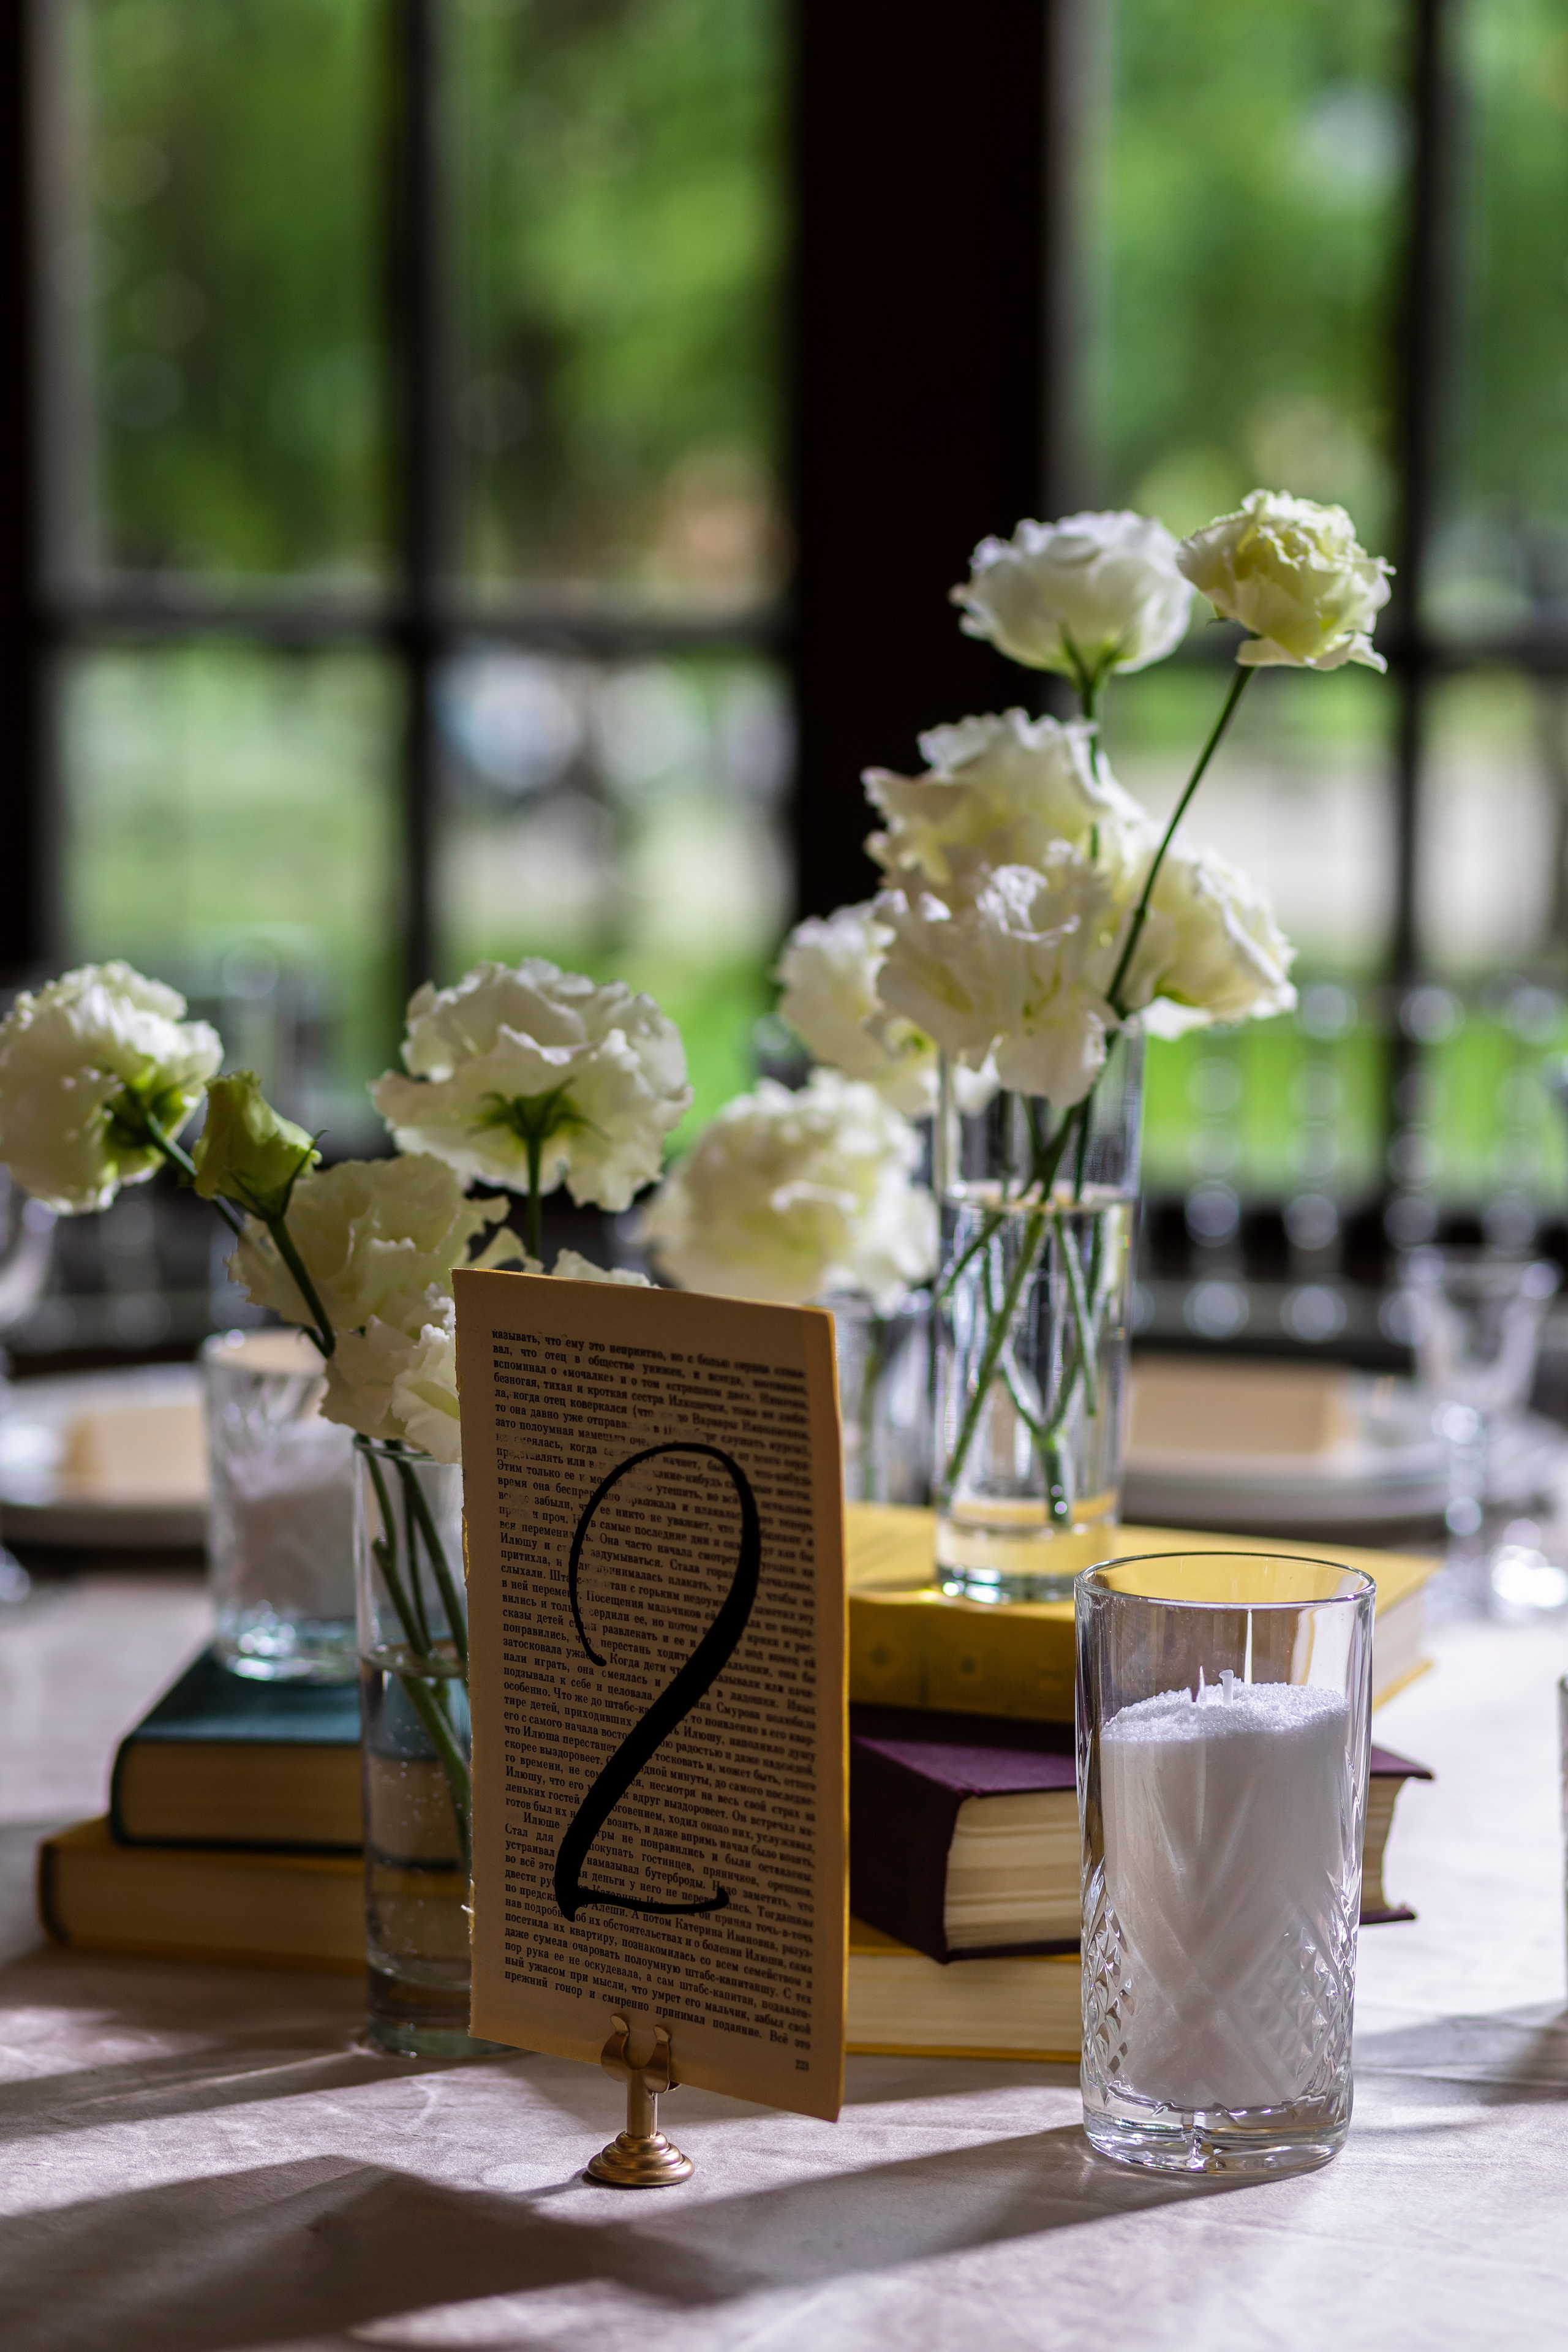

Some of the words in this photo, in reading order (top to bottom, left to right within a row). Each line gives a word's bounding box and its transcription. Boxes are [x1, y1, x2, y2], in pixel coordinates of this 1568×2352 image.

[491, 1330, 541, 1346] казывать,
[544, 1336, 562, 1347] что
[565, 1338, 586, 1352] ему
[588, 1341, 606, 1352] это
[492, 1344, 513, 1357] вал,
[519, 1348, 538, 1359] что
[544, 1351, 568, 1364] отец
[587, 1354, 635, 1371] обществе
[492, 1359, 547, 1374] вспоминал
[562, 1368, 614, 1383] «мочалке»
[493, 1371, 540, 1390] безногая,
[543, 1380, 573, 1393] тихая
[587, 1386, 628, 1400] кроткая
[631, 1392, 665, 1406] сестра
[494, 1389, 510, 1401] ла,
[512, 1391, 541, 1404] когда
[543, 1395, 567, 1408] отец
[569, 1398, 628, 1415] коверкался
[494, 1403, 507, 1413] то
[509, 1405, 527, 1416] она
[529, 1408, 560, 1420] давно
[562, 1412, 584, 1424] уже
[495, 1417, 517, 1429] зато
[518, 1421, 575, 1437] полоумная
[566, 1457, 586, 1468] или
[569, 1442, 598, 1456] когда
[497, 1458, 523, 1474] Этим
[526, 1466, 561, 1479] только
[564, 1471, 575, 1481] ее
[497, 1476, 528, 1489] время
[532, 1481, 551, 1492] она
[533, 1494, 574, 1512] забыли,
[615, 1508, 646, 1521] никто
[541, 1512, 569, 1525] проч.
[599, 1521, 631, 1534] самые
[634, 1526, 687, 1541] последние
[599, 1532, 620, 1547] Она
[624, 1539, 653, 1551] часто
[500, 1531, 538, 1551] Илюшу
[590, 1548, 663, 1569] задумываться.
[500, 1549, 551, 1567] притихла,
[500, 1564, 546, 1580] слыхали.
[638, 1586, 680, 1601] горьким
[510, 1579, 529, 1592] ней
[502, 1594, 538, 1607] вились
[633, 1615, 648, 1627] ее,
[652, 1618, 665, 1628] но
[502, 1608, 532, 1621] сказы
[536, 1613, 565, 1626] детей
[601, 1624, 658, 1642] развлекать
[502, 1623, 570, 1644] понравились,
[600, 1638, 652, 1656] перестань
[502, 1637, 563, 1656] затосковала
[609, 1652, 640, 1670] Когда
[643, 1660, 666, 1673] дети
[503, 1652, 527, 1664] нали
[533, 1657, 570, 1674] играть,
[576, 1665, 595, 1676] она
[601, 1669, 648, 1685] смеялась
[503, 1666, 556, 1684] подзывала
[570, 1677, 592, 1691] себе
[607, 1685, 656, 1702] целовала.
[554, 1442, 761, 1922] 2
[503, 1681, 551, 1698] особенно.
[552, 1686, 573, 1702] Что
[573, 1694, 589, 1705] же
[590, 1697, 603, 1708] до
[503, 1695, 527, 1709] тире
[529, 1700, 560, 1716] детей,
[564, 1706, 633, 1727] приходивших
[503, 1711, 520, 1722] его
[528, 1715, 563, 1729] самого
[564, 1721, 599, 1736] начала
[675, 1742, 723, 1758] радостью
[504, 1725, 521, 1736] что
[522, 1724, 560, 1743] Илюша
[562, 1735, 617, 1754] перестанет
[654, 1752, 704, 1770] тосковать
[503, 1740, 538, 1754] скорее
[539, 1746, 603, 1766] выздоровеет.
[669, 1770, 712, 1788] минуты,
[504, 1754, 516, 1763] го
[519, 1756, 564, 1774] времени,
[568, 1765, 581, 1776] не
[649, 1781, 696, 1800] несмотря
[505, 1765, 546, 1785] Илюшу,
[548, 1776, 566, 1787] что
[568, 1780, 585, 1791] его
[632, 1792, 662, 1807] вдруг
[505, 1782, 546, 1799] леньких
[548, 1791, 581, 1805] гостей
[668, 1814, 698, 1828] ходил
[505, 1797, 532, 1811] готов
[532, 1800, 553, 1815] был
[554, 1806, 568, 1817] их
[606, 1817, 642, 1834] возить,
[652, 1826, 679, 1839] даже
[680, 1832, 718, 1847] впрямь
[504, 1822, 529, 1838] Стал
[535, 1831, 554, 1843] для
[641, 1853, 695, 1874] гостинцев,
[523, 1811, 560, 1830] Илюше
[621, 1834, 634, 1845] не
[639, 1838, 705, 1859] понравились
[504, 1853, 517, 1864] во
[519, 1856, 536, 1868] всё
[538, 1861, 555, 1872] это
[591, 1872, 625, 1887] деньги
[639, 1882, 662, 1895] него
[665, 1888, 678, 1898] не
[504, 1869, 537, 1883] двести
[505, 1839, 556, 1858] устраивал
[586, 1856, 639, 1875] намазывал
[644, 1866, 706, 1890] бутерброды.
[505, 1883, 518, 1893] по
[642, 1912, 672, 1928] потом
[674, 1917, 723, 1939] Катерина
[505, 1898, 522, 1909] нав
[575, 1912, 587, 1924] об
[588, 1916, 601, 1927] их
[602, 1917, 683, 1945] обстоятельствах
[701, 1939, 742, 1958] болезни
[504, 1912, 549, 1930] посетила
[552, 1922, 566, 1934] их
[569, 1926, 618, 1947] квартиру,
[621, 1938, 696, 1963] познакомилась
[504, 1927, 530, 1940] даже
[532, 1933, 568, 1949] сумела
[571, 1942, 621, 1961] очаровать
[624, 1953, 682, 1975] полоумную
[504, 1941, 522, 1956] пор
[526, 1946, 550, 1959] рука
[553, 1952, 565, 1962] ее
[568, 1955, 581, 1966] не
[584, 1959, 642, 1982] оскудевала,
[656, 1976, 675, 1988] сам
[679, 1981, 757, 2007] штабс-капитан,
[504, 1956, 525, 1969] ный
[527, 1961, 566, 1978] ужасом
[569, 1970, 589, 1984] при
[592, 1975, 628, 1994] мысли,
[631, 1984, 649, 1996] что
[651, 1989, 682, 2004] умрет
[684, 1997, 701, 2009] его
[704, 2002, 750, 2022] мальчик,
[504, 1970, 548, 1989] прежний
[554, 1982, 583, 1999] гонор
[601, 1993, 650, 2012] смиренно
[655, 2005, 706, 2026] принимал
